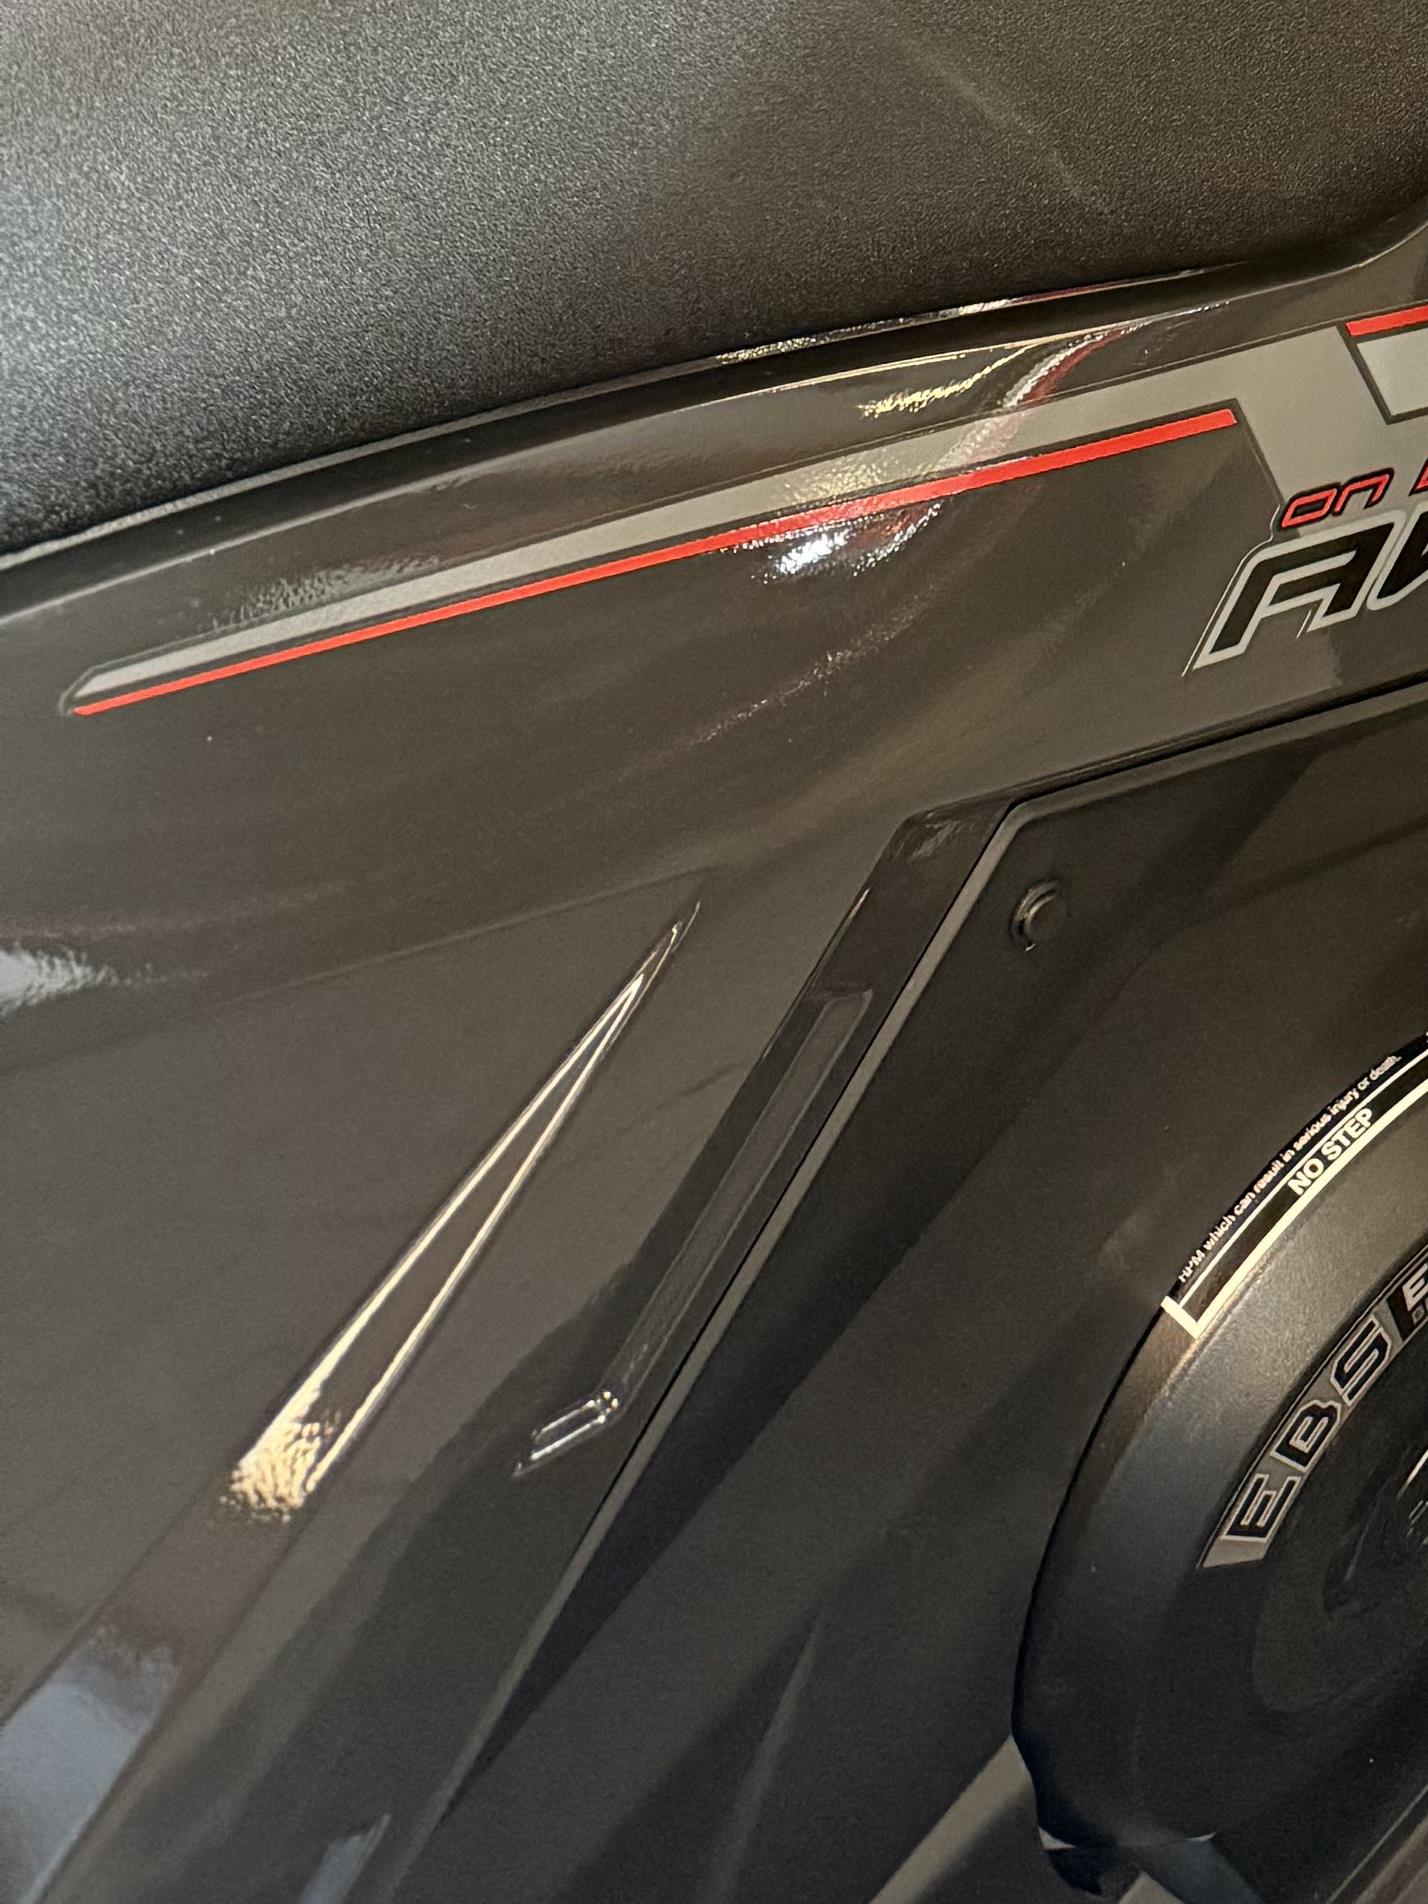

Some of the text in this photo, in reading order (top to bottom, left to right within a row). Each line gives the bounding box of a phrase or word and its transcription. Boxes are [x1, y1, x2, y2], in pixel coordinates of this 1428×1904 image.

[1281, 470, 1395, 529] ON
[1200, 1211, 1237, 1250] which
[1232, 1191, 1256, 1215] can
[1251, 1157, 1285, 1192] result
[1280, 1146, 1295, 1161] in
[1291, 1109, 1332, 1152] serious
[1327, 1085, 1359, 1117] injury
[1356, 1076, 1371, 1090] or
[1367, 1049, 1401, 1083] death.
[1287, 1104, 1376, 1195] NO STEP
[1221, 1321, 1394, 1541] EBS
